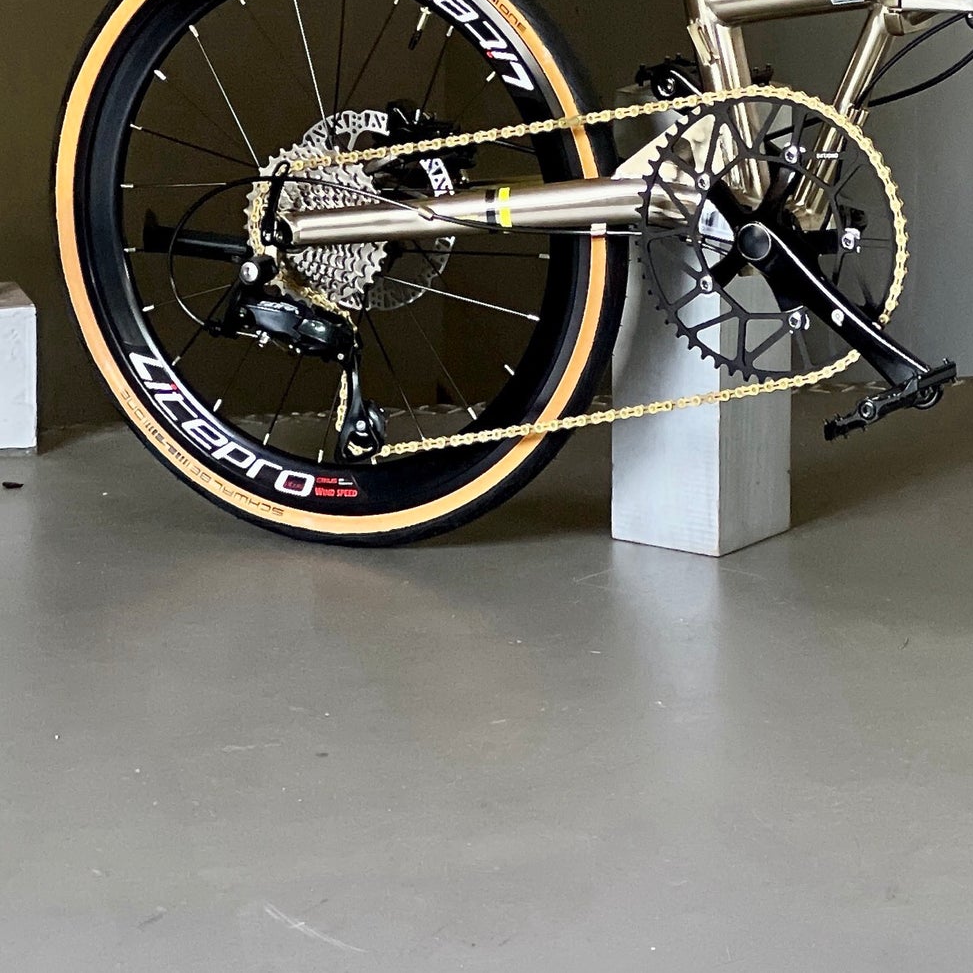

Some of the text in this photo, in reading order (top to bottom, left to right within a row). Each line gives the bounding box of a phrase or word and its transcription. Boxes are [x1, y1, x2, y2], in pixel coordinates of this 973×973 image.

[498, 3, 528, 33] ONE
[120, 387, 285, 517] SCHWALBE ONE
